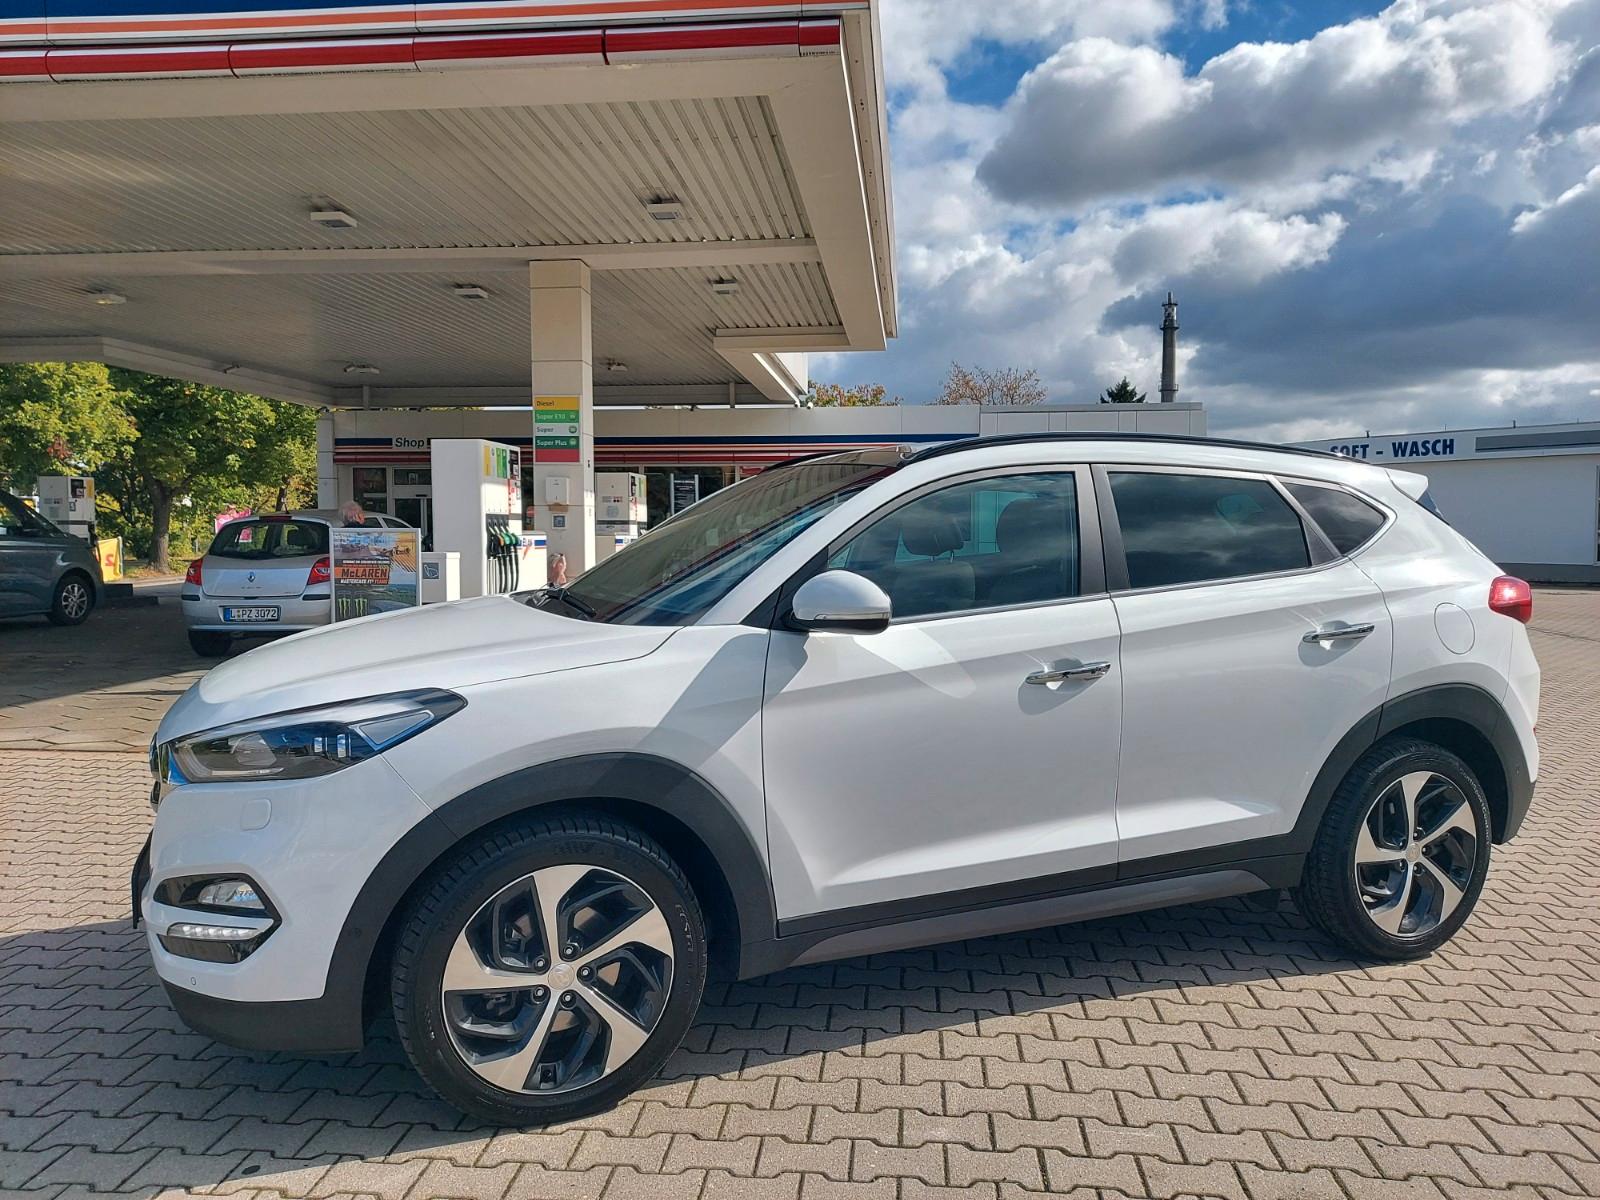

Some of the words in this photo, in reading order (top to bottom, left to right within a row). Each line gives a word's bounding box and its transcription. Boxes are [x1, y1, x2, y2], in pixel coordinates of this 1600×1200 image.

[395, 437, 424, 449] Shop
[555, 439, 568, 447] Plus
[1392, 439, 1454, 457] WASCH
[341, 568, 388, 578] McLAREN
[241, 609, 253, 618] PZ
[254, 609, 277, 618] 3072
